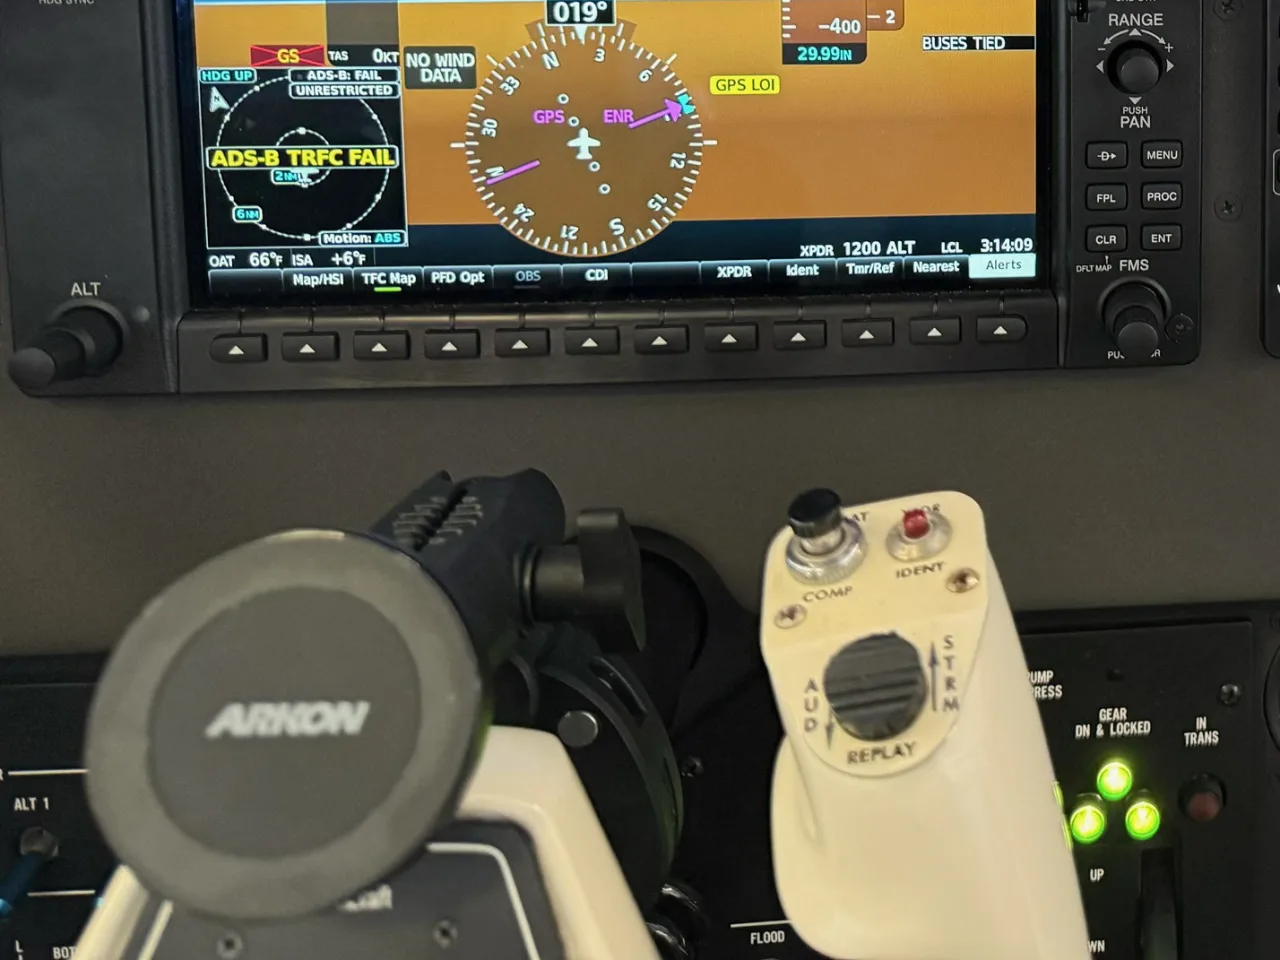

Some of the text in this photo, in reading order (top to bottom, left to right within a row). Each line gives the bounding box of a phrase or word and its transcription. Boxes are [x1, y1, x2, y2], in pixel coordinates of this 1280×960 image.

[1108, 13, 1164, 27] RANGE
[922, 36, 1006, 51] BUSES TIED
[405, 53, 475, 68] NO WIND
[420, 69, 462, 83] DATA
[296, 85, 393, 96] UNRESTRICTED
[715, 78, 776, 92] GPS LOI
[532, 110, 565, 124] GPS
[1120, 116, 1151, 129] PAN
[211, 149, 395, 167] ADS-B TRFC FAIL
[1146, 150, 1178, 160] MENU
[1147, 192, 1177, 201] PROC
[800, 240, 916, 257] XPDR 1200 ALT
[980, 238, 1033, 253] 3:14:09
[209, 256, 235, 267] OAT
[913, 260, 960, 274] Nearest
[986, 259, 1022, 271] Alerts
[1119, 259, 1149, 271] FMS
[293, 272, 344, 288] Map/HSI
[362, 271, 416, 287] TFC Map
[431, 271, 485, 286] PFD Opt
[71, 283, 101, 297] ALT
[896, 561, 945, 579] IDENT
[802, 586, 853, 604] COMP
[205, 700, 370, 738] ARKON
[1099, 707, 1127, 722] GEAR
[1075, 720, 1151, 739] DN LOCKED
[1184, 730, 1219, 746] TRANS
[847, 741, 917, 765] REPLAY
[750, 930, 785, 945] FLOOD
